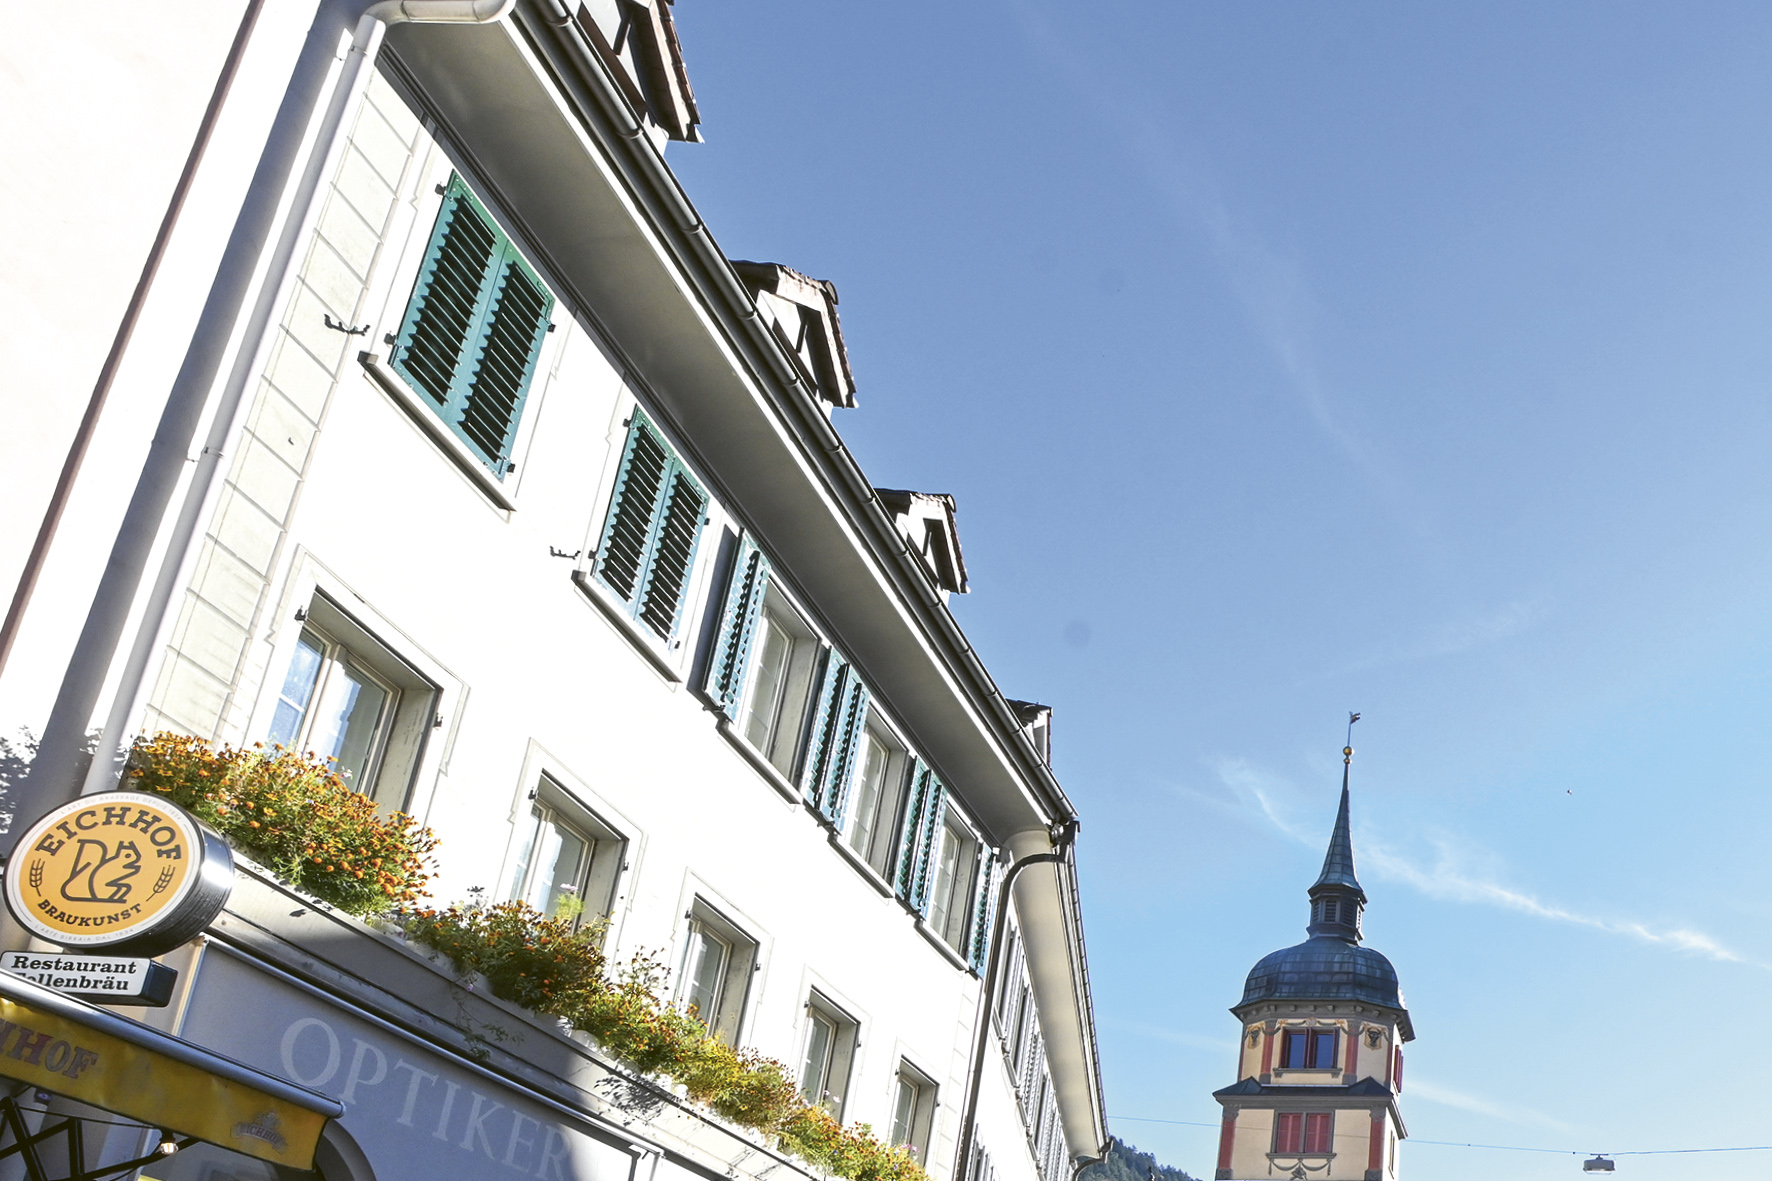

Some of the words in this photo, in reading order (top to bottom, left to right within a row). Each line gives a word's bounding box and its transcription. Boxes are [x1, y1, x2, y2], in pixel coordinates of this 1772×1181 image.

[34, 806, 182, 860] EICHHOF
[37, 898, 143, 927] BRAUKUNST
[11, 955, 137, 975] Restaurant
